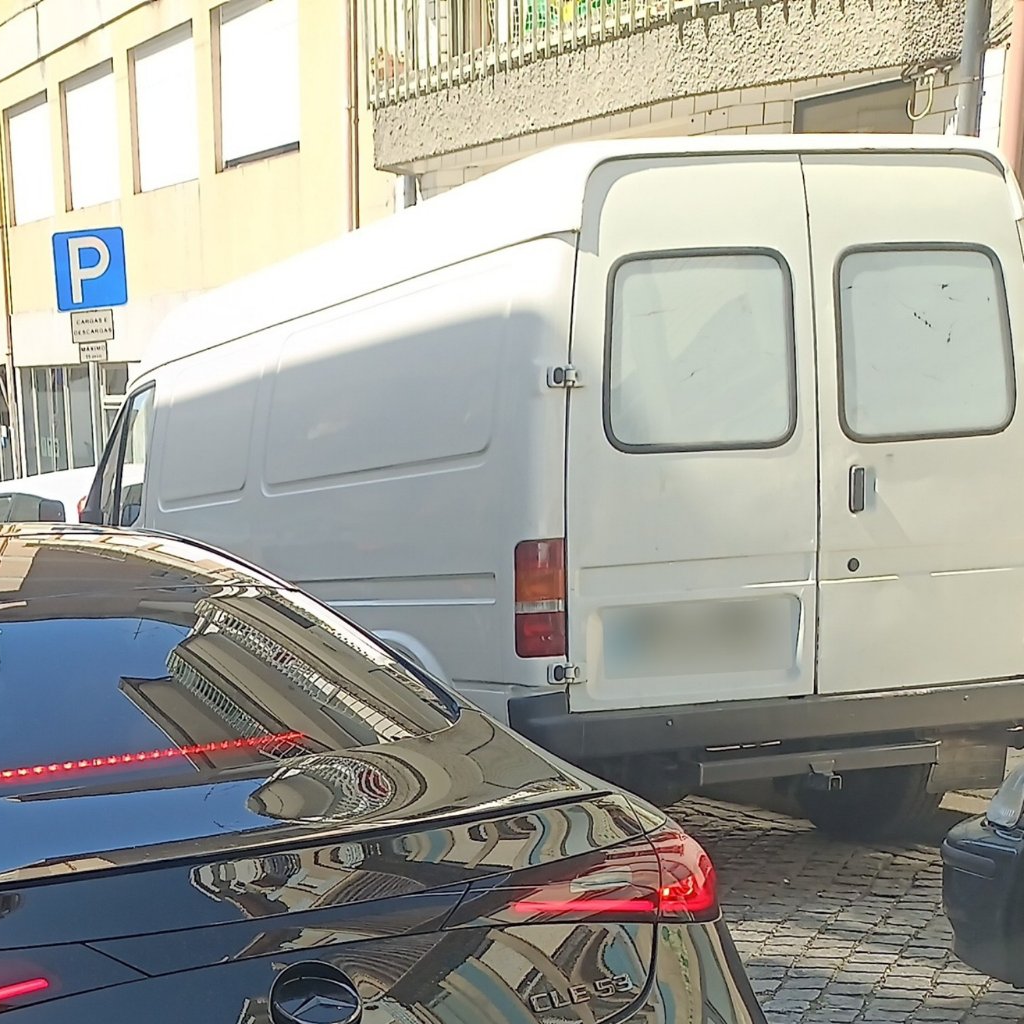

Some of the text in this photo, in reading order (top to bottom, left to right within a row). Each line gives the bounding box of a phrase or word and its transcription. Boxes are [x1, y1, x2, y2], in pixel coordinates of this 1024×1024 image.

[67, 235, 111, 304] P
[74, 327, 112, 335] DESCARGAS
[529, 973, 634, 1012] CLE 53
